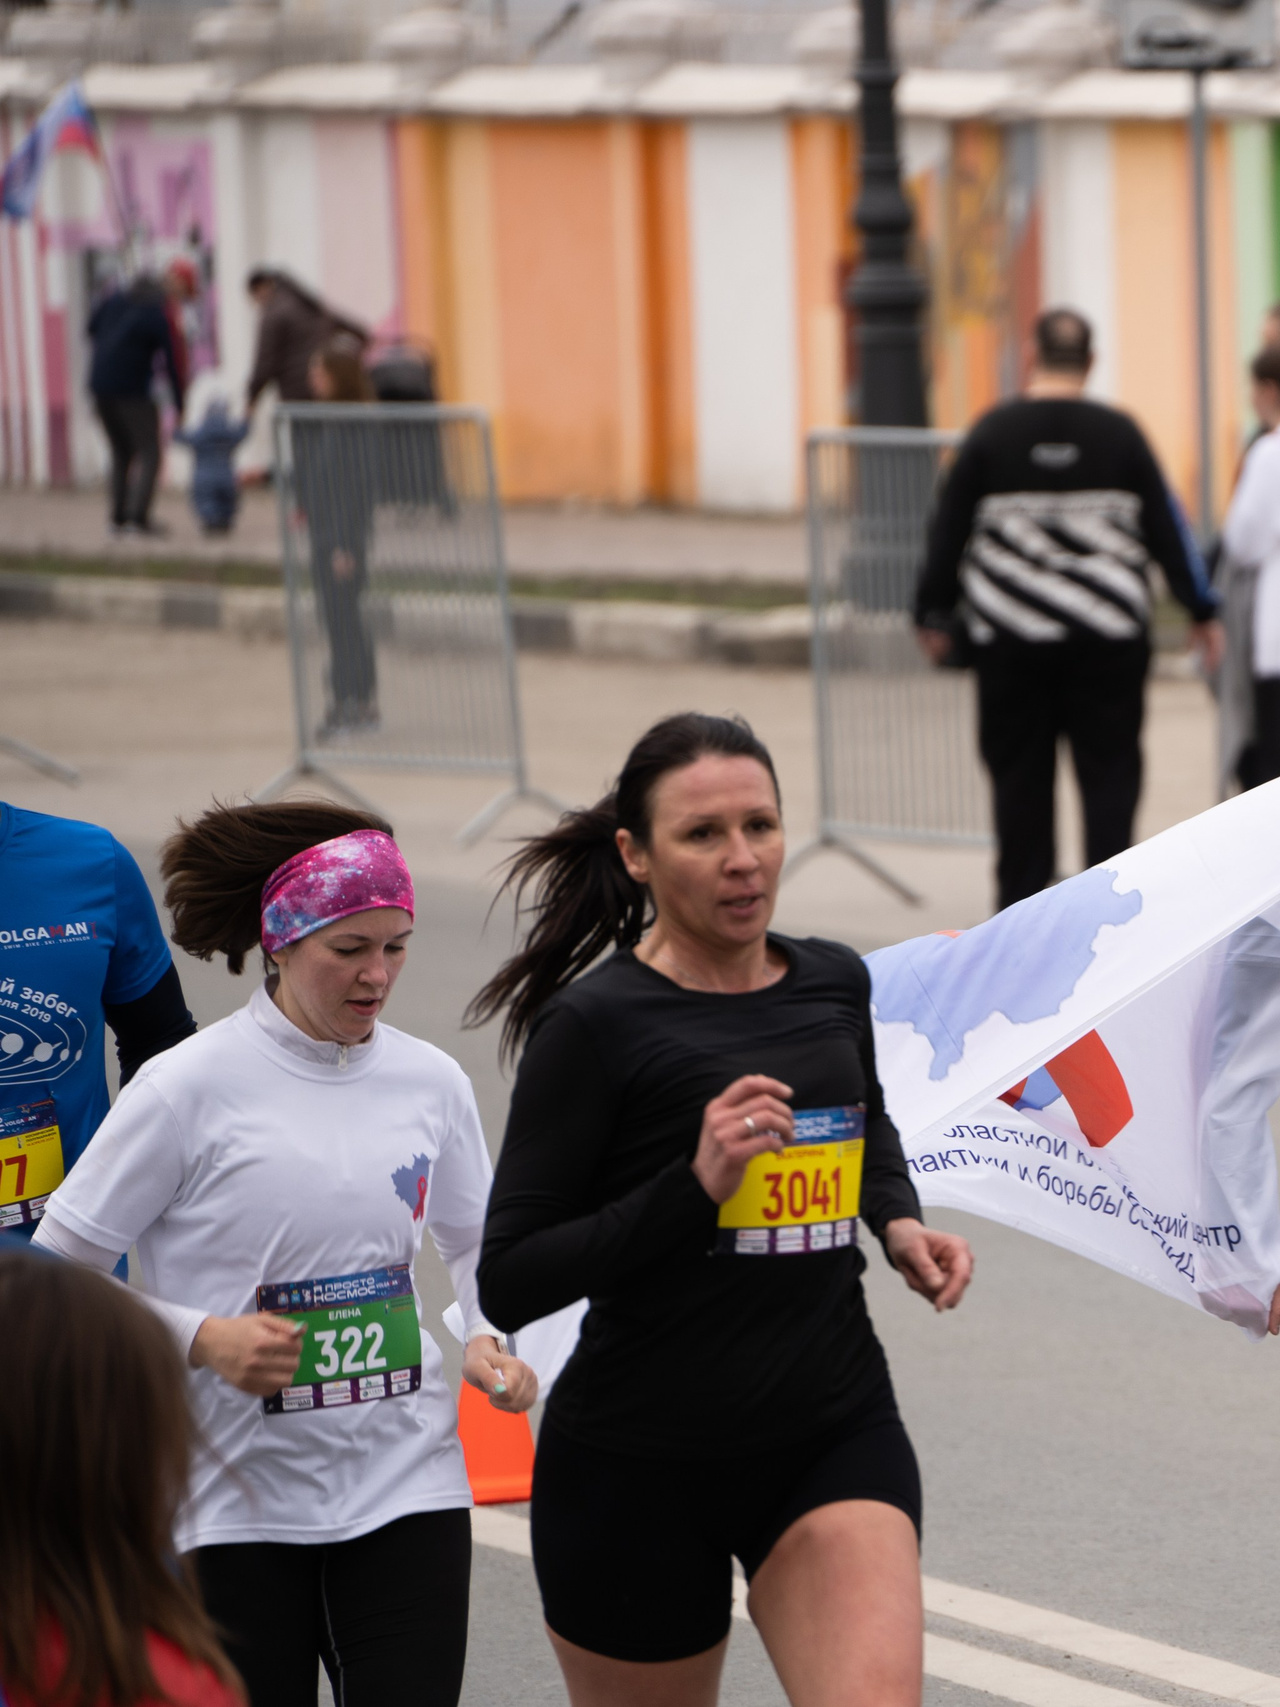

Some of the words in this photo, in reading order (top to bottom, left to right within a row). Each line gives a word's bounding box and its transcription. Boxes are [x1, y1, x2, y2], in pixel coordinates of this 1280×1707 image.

[19, 986, 78, 1018] забег
[21, 1003, 52, 1023] 2019
[762, 1165, 842, 1221] 3041
[1037, 1165, 1124, 1218] борьбы
[313, 1285, 376, 1303] КОСМОС
[325, 1276, 375, 1292] ПРОСТО
[328, 1307, 362, 1322] ЕЛЕНА
[313, 1321, 387, 1378] 322
